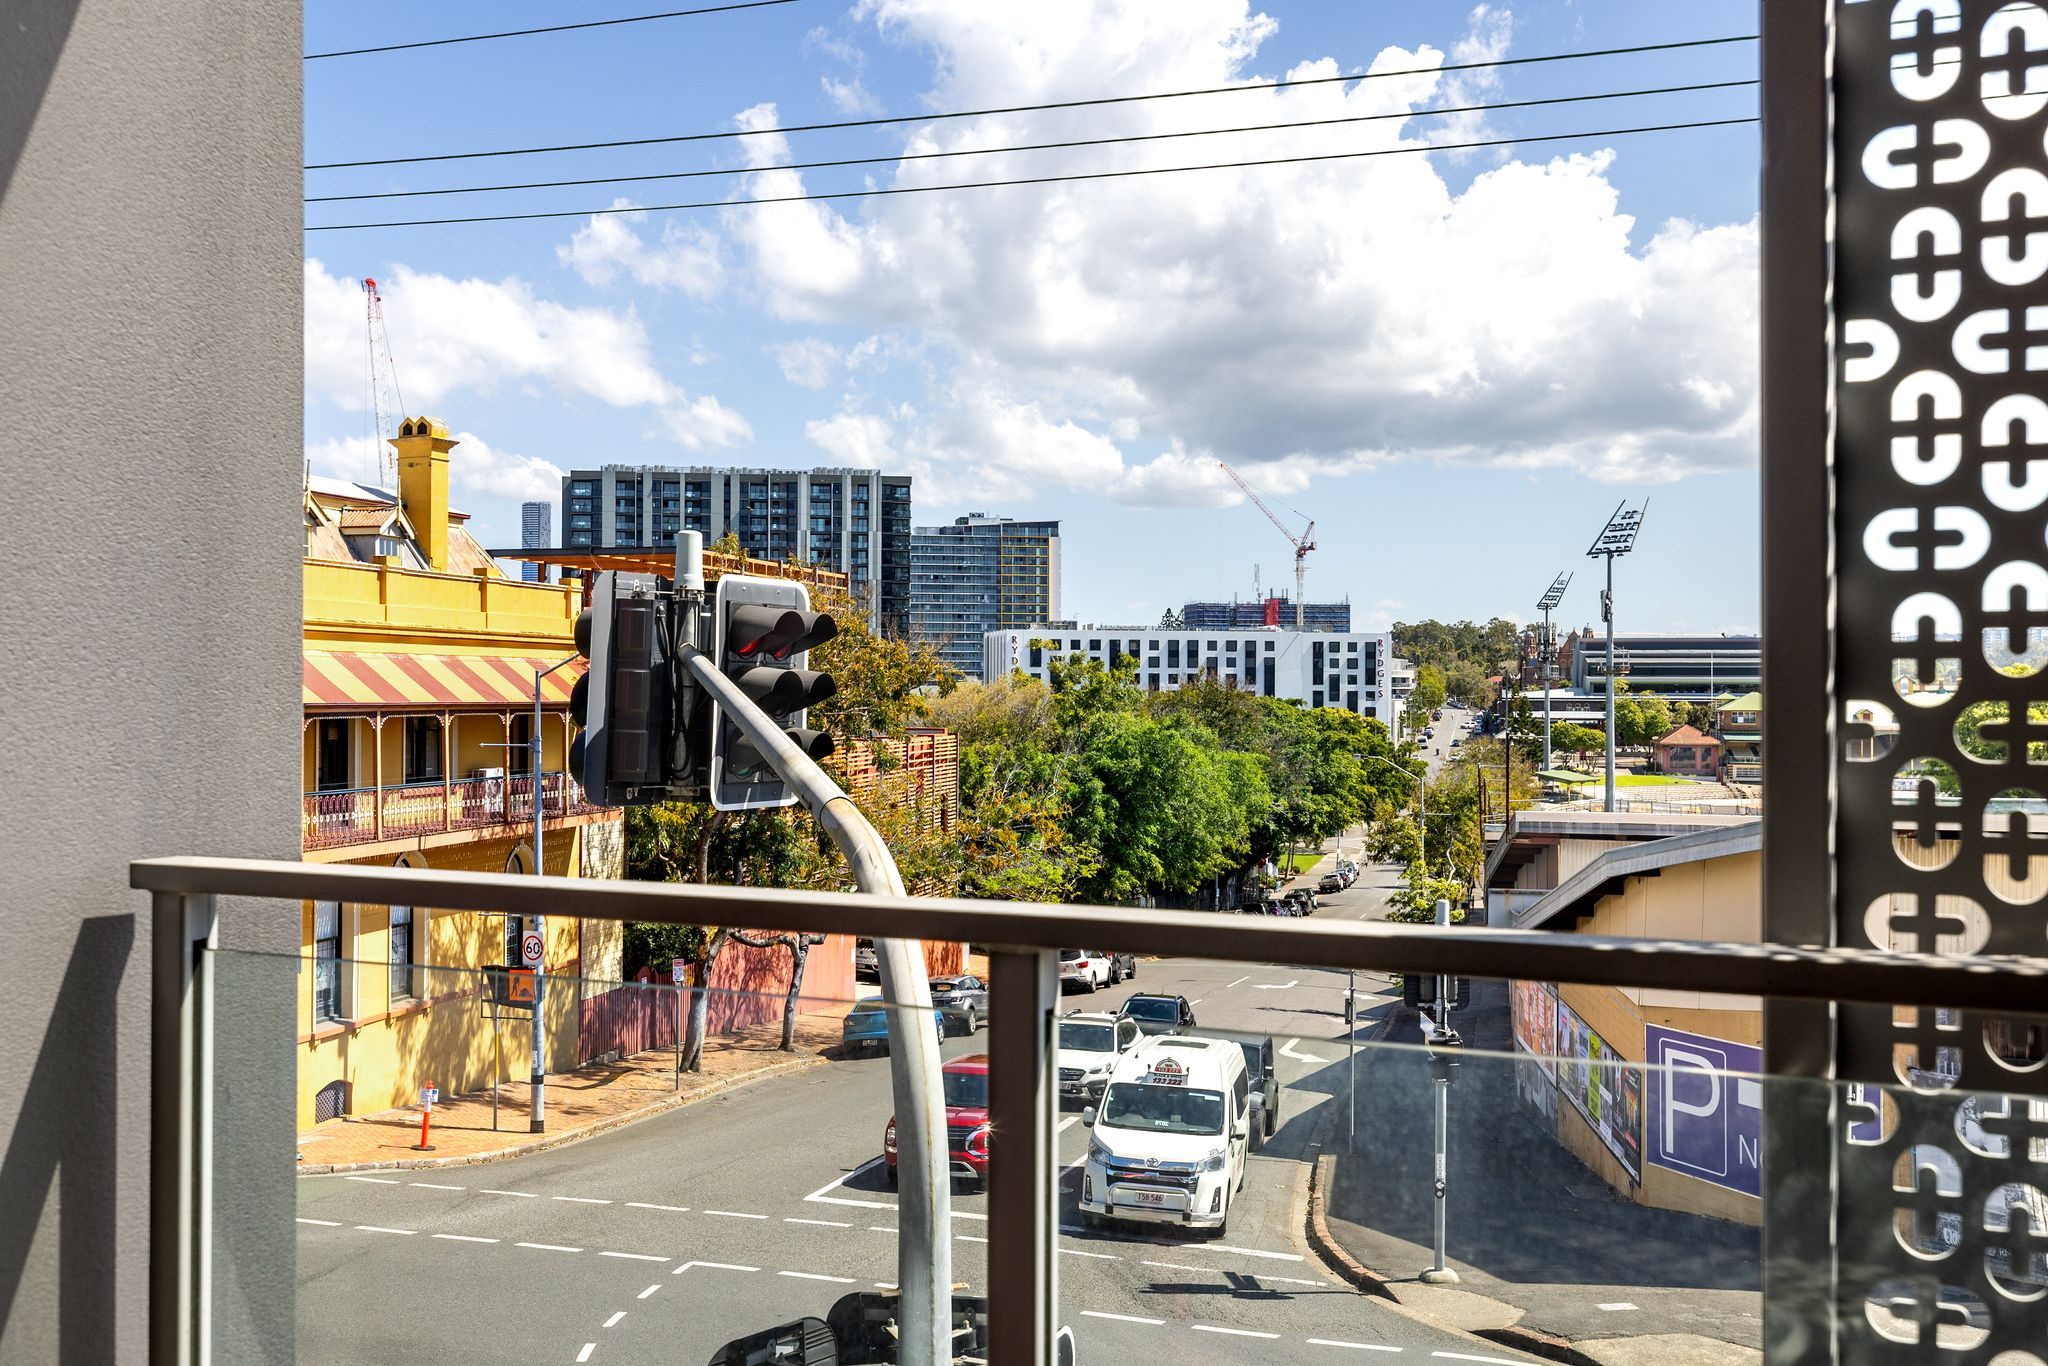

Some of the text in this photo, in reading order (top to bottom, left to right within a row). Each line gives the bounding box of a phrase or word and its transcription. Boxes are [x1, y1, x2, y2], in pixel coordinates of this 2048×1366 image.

[1377, 639, 1385, 698] RYDGES
[526, 942, 540, 955] 60
[1665, 1047, 1720, 1154] P
